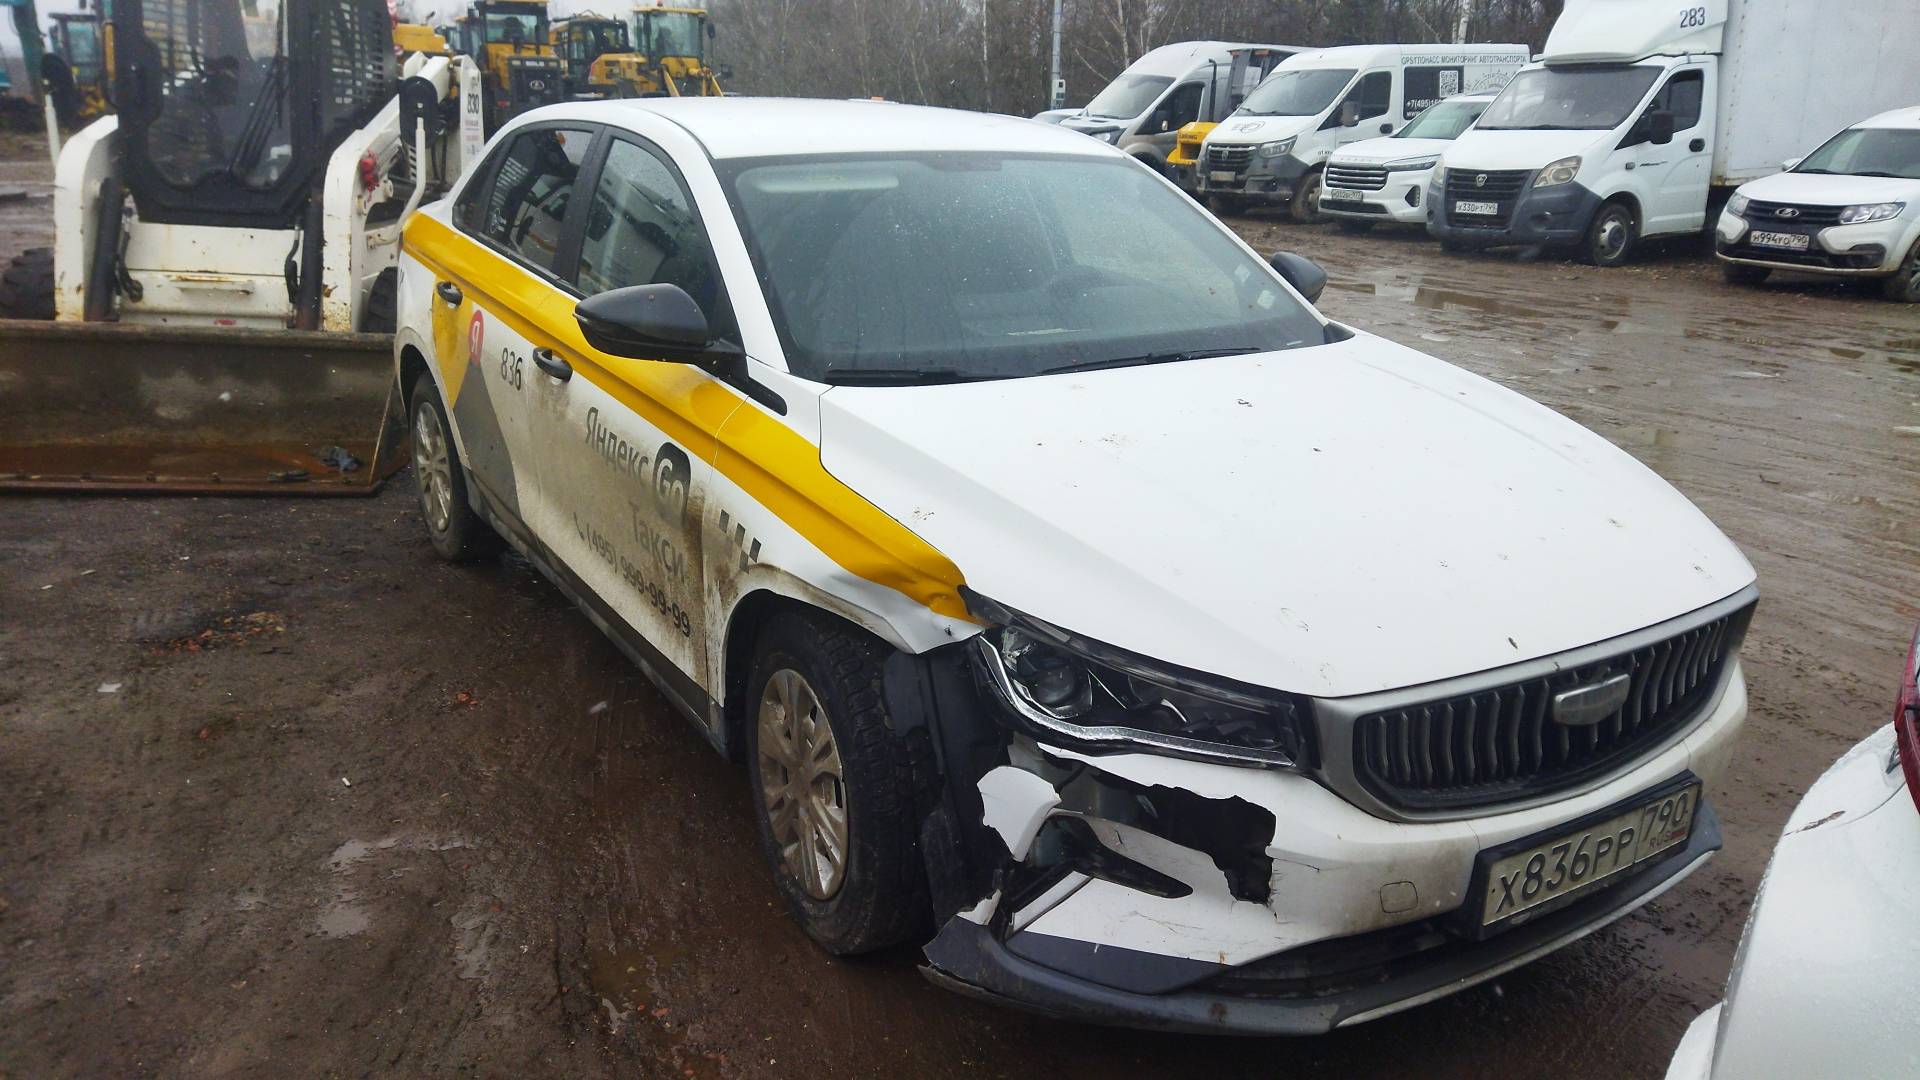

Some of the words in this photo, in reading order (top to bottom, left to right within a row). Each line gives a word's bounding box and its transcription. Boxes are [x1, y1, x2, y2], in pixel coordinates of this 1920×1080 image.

[1680, 6, 1705, 28] 283
[467, 92, 480, 114] 830
[471, 320, 480, 355] Я
[501, 347, 523, 391] 836
[585, 406, 650, 485] Яндекс
[656, 457, 685, 514] Go
[585, 522, 618, 574] (495)
[620, 555, 691, 637] 999-99-99
[1495, 827, 1635, 913] Х836РР
[1642, 793, 1688, 841] 790
[1649, 830, 1672, 850] RUS
